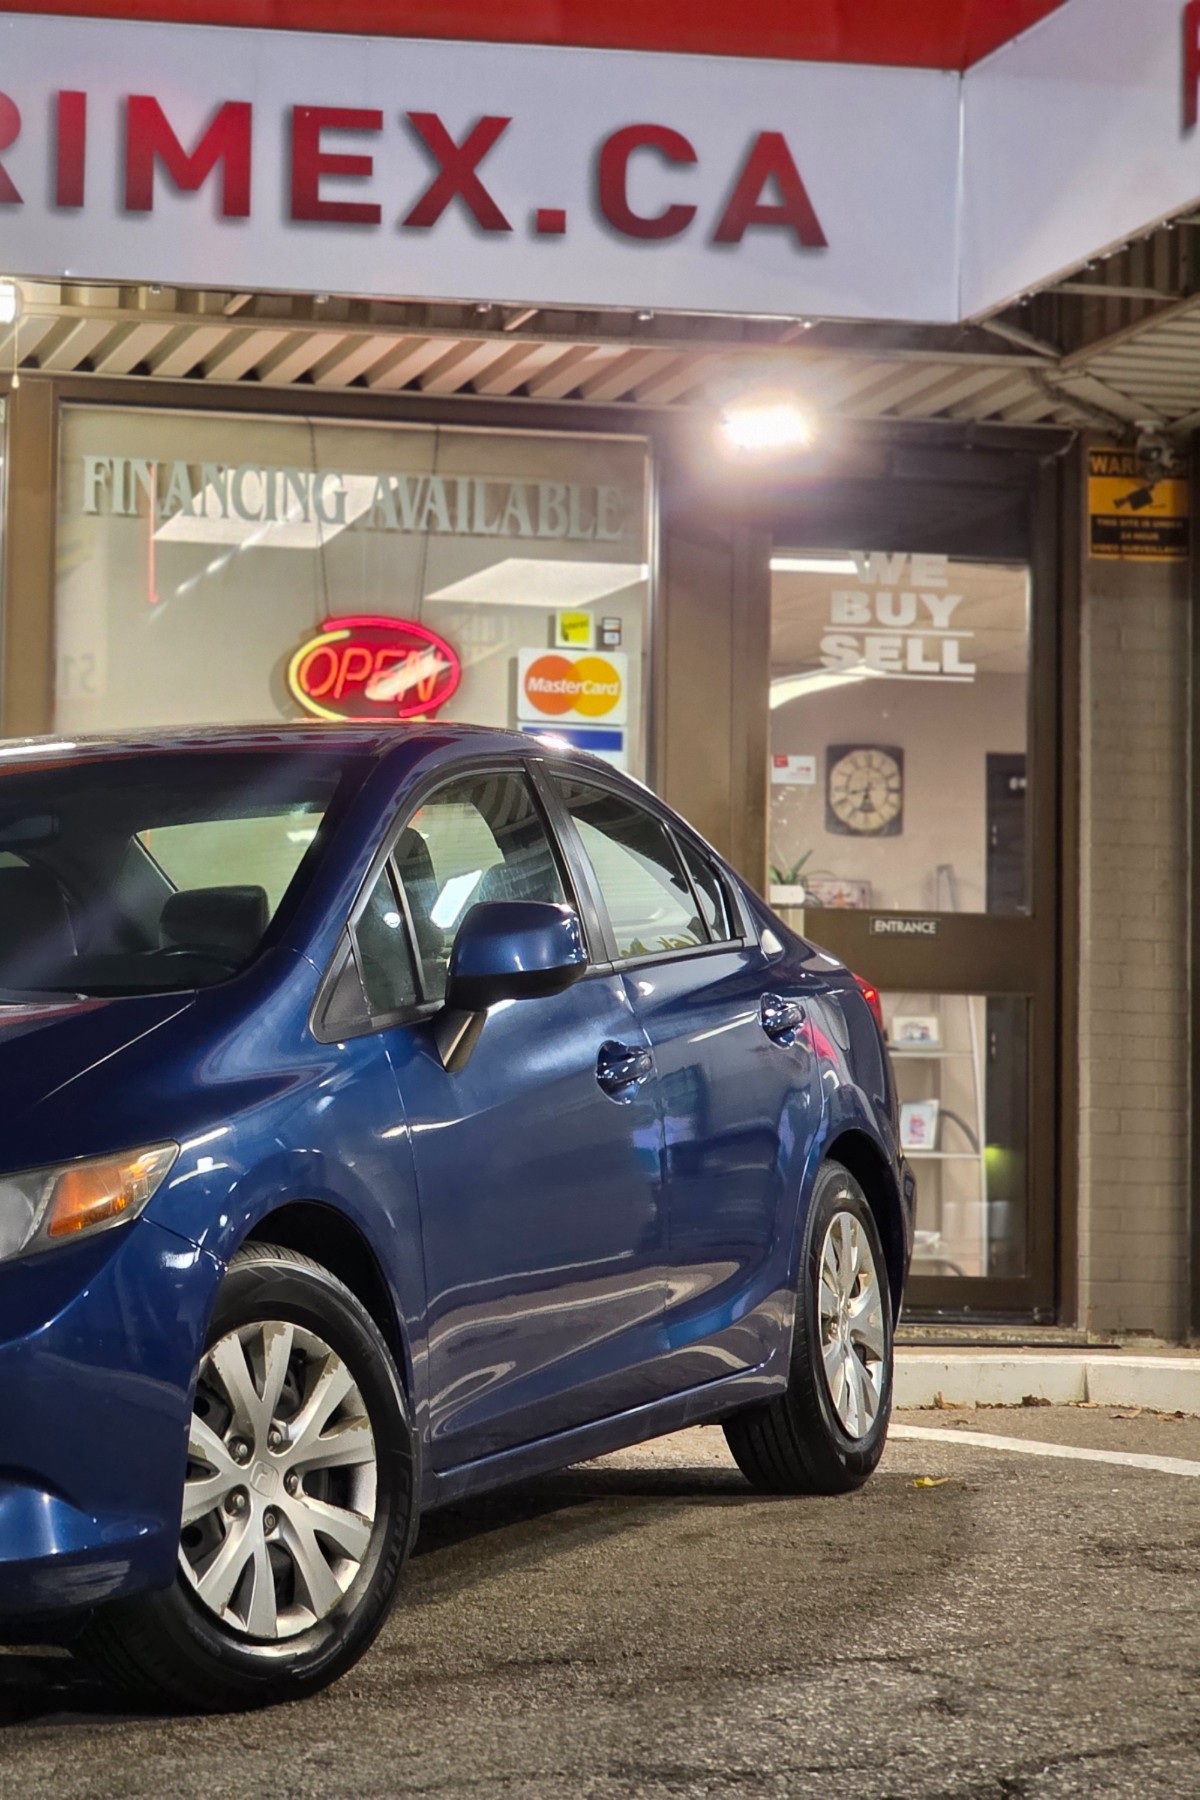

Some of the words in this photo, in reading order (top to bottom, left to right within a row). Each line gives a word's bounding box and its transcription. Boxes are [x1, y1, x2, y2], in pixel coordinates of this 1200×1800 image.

[81, 454, 349, 525] FINANCING
[365, 474, 625, 541] AVAILABLE
[849, 550, 949, 588] WE
[830, 590, 964, 629] BUY
[818, 633, 977, 674] SELL
[300, 645, 443, 702] OPEN
[527, 676, 619, 696] MasterCard
[874, 919, 937, 935] ENTRANCE
